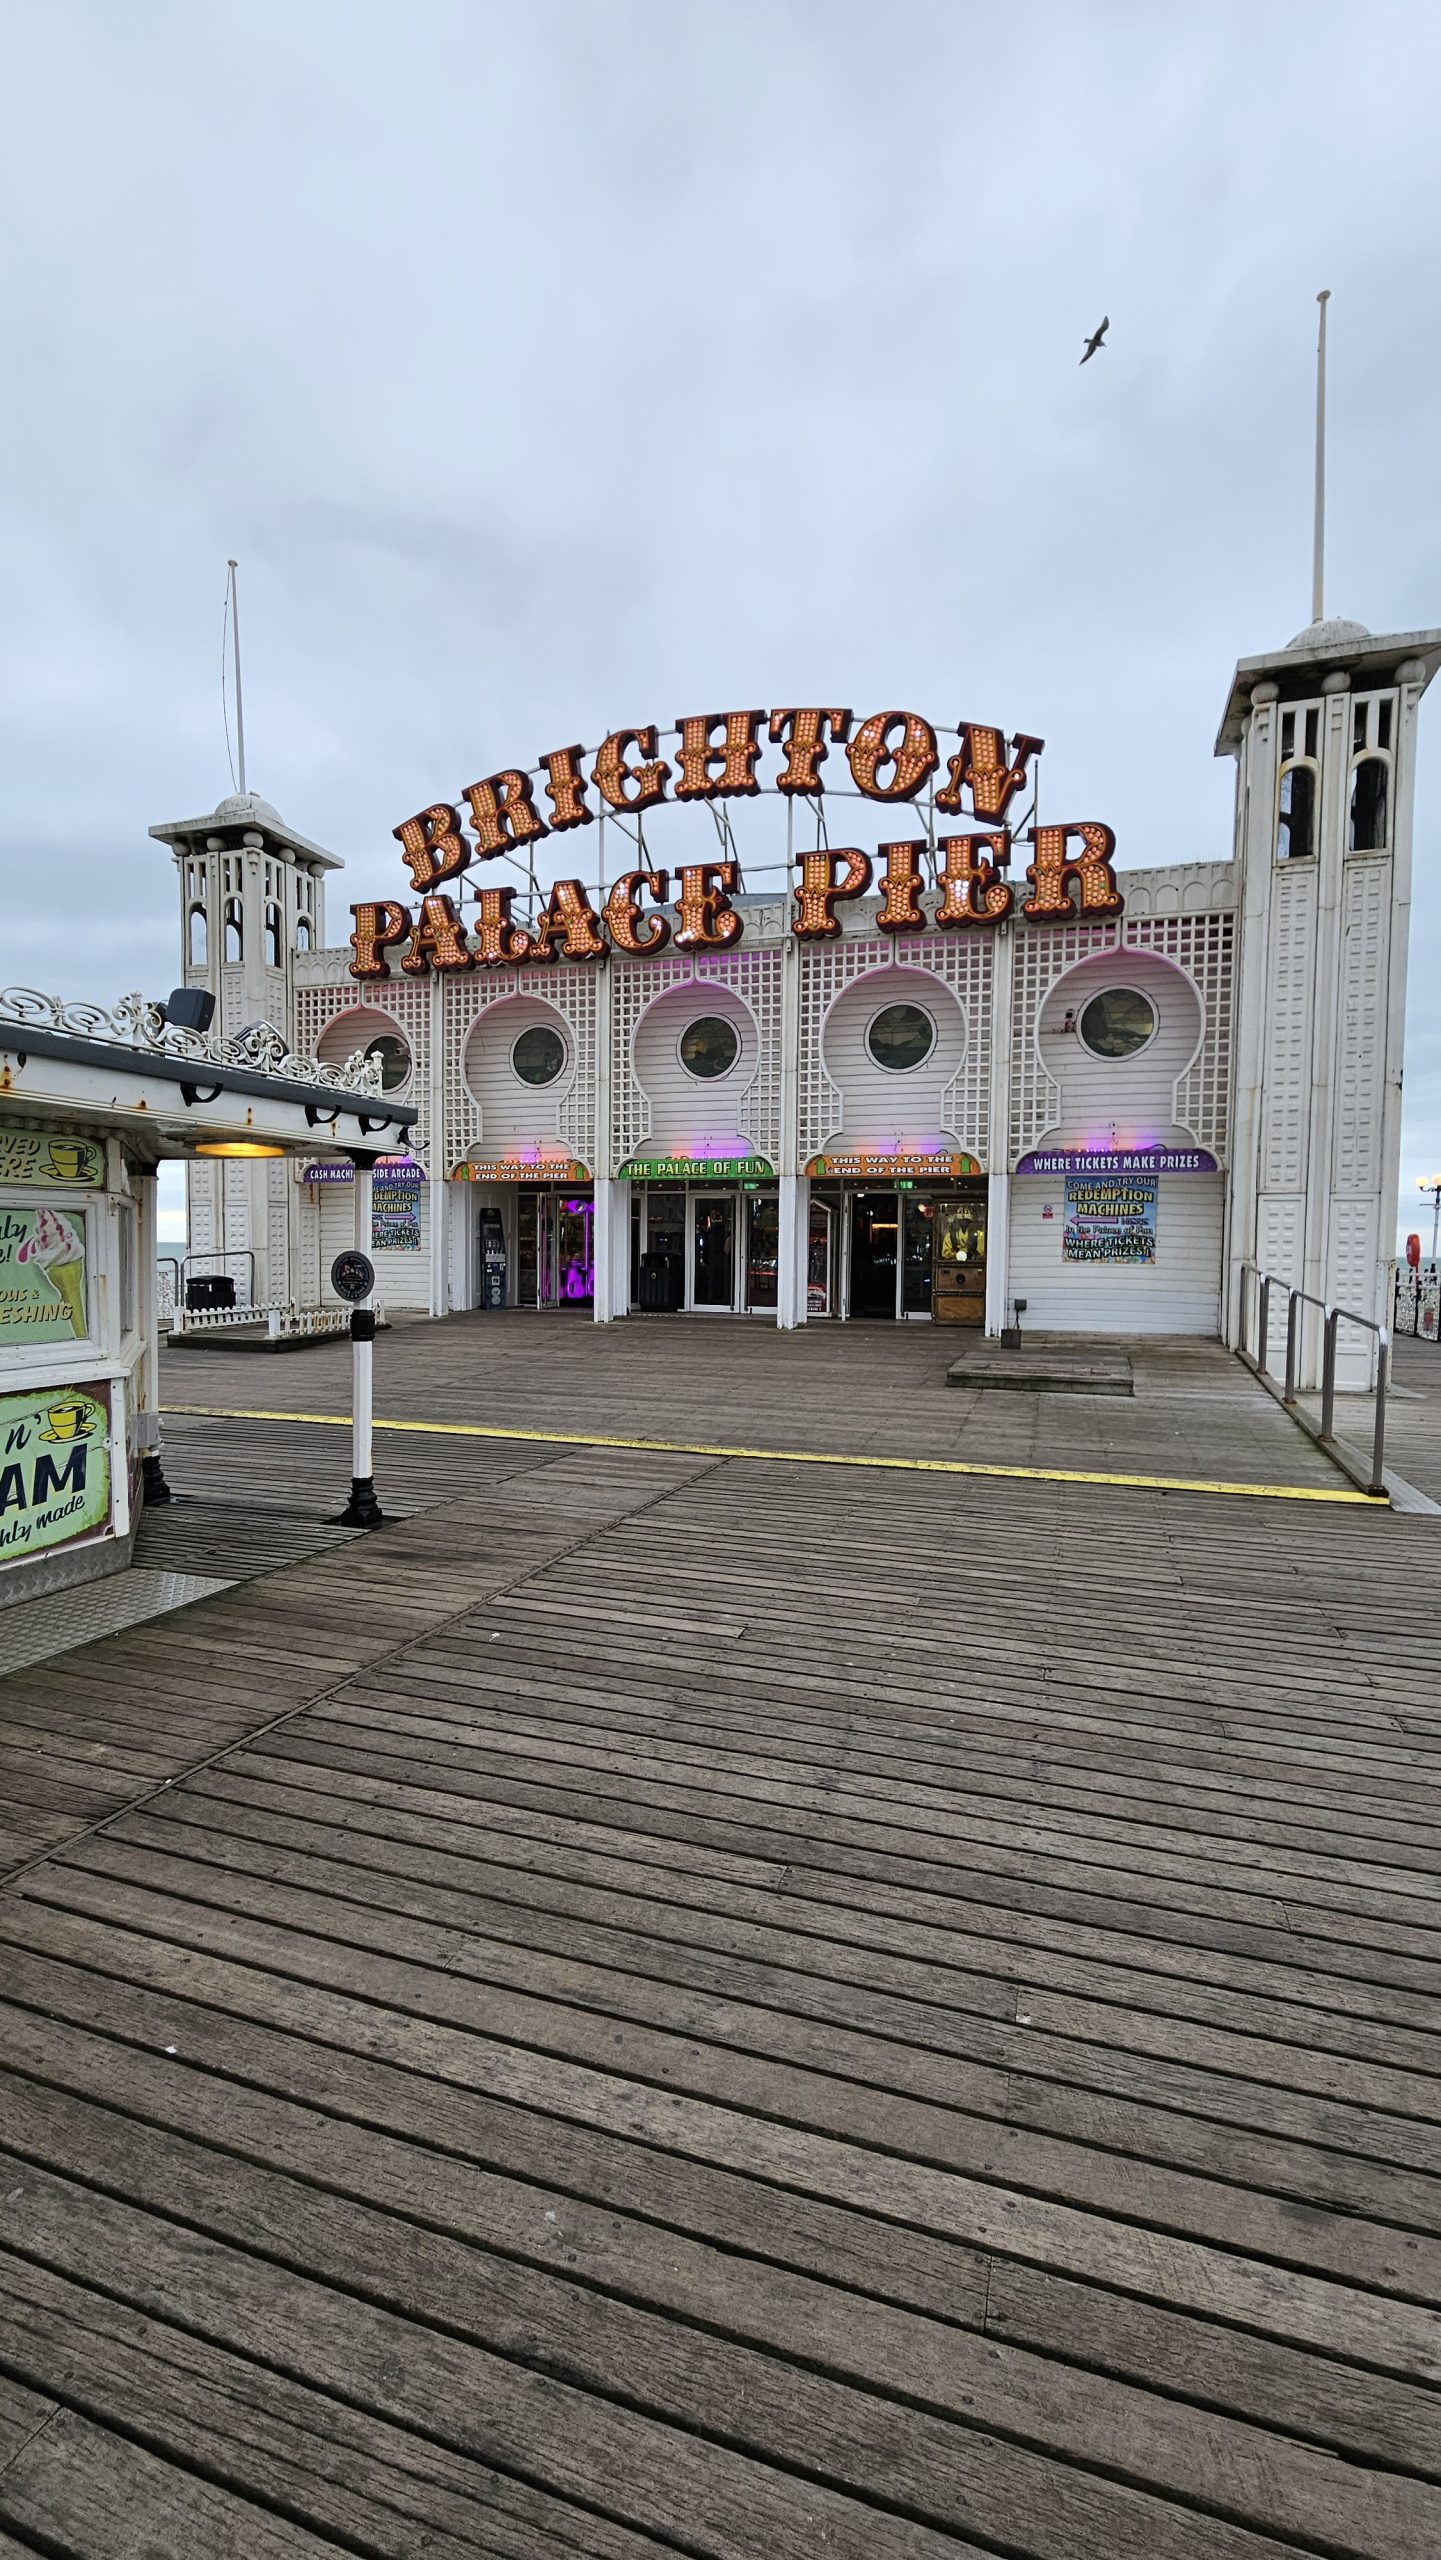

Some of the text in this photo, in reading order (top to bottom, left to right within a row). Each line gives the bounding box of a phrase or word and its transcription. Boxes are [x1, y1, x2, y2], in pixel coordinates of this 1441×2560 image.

[392, 708, 1045, 894] BRIGHTON
[349, 821, 1125, 981] PALACE PIER
[0, 1136, 41, 1156] VED
[831, 1156, 955, 1164] THIS WAY TO THE
[1033, 1154, 1199, 1170] WHERE TICKETS MAKE PRIZES
[310, 1170, 328, 1179] CASH
[391, 1168, 421, 1178] ARCADE
[500, 1163, 526, 1171] WAY
[626, 1161, 765, 1176] THE PALACE OF FUN
[889, 1166, 916, 1174] THE
[918, 1166, 950, 1174] PIER
[406, 1181, 419, 1189] OUR
[1067, 1176, 1157, 1191] COME AND TRY OUR
[1068, 1187, 1154, 1202] REDEMPTION
[1076, 1202, 1144, 1216] MACHINES
[390, 1229, 419, 1237] TICKETS
[1065, 1236, 1154, 1248] WHERE TICKETS
[1067, 1248, 1101, 1259] MEAN
[31, 1289, 40, 1300] &
[36, 1495, 86, 1529] made
